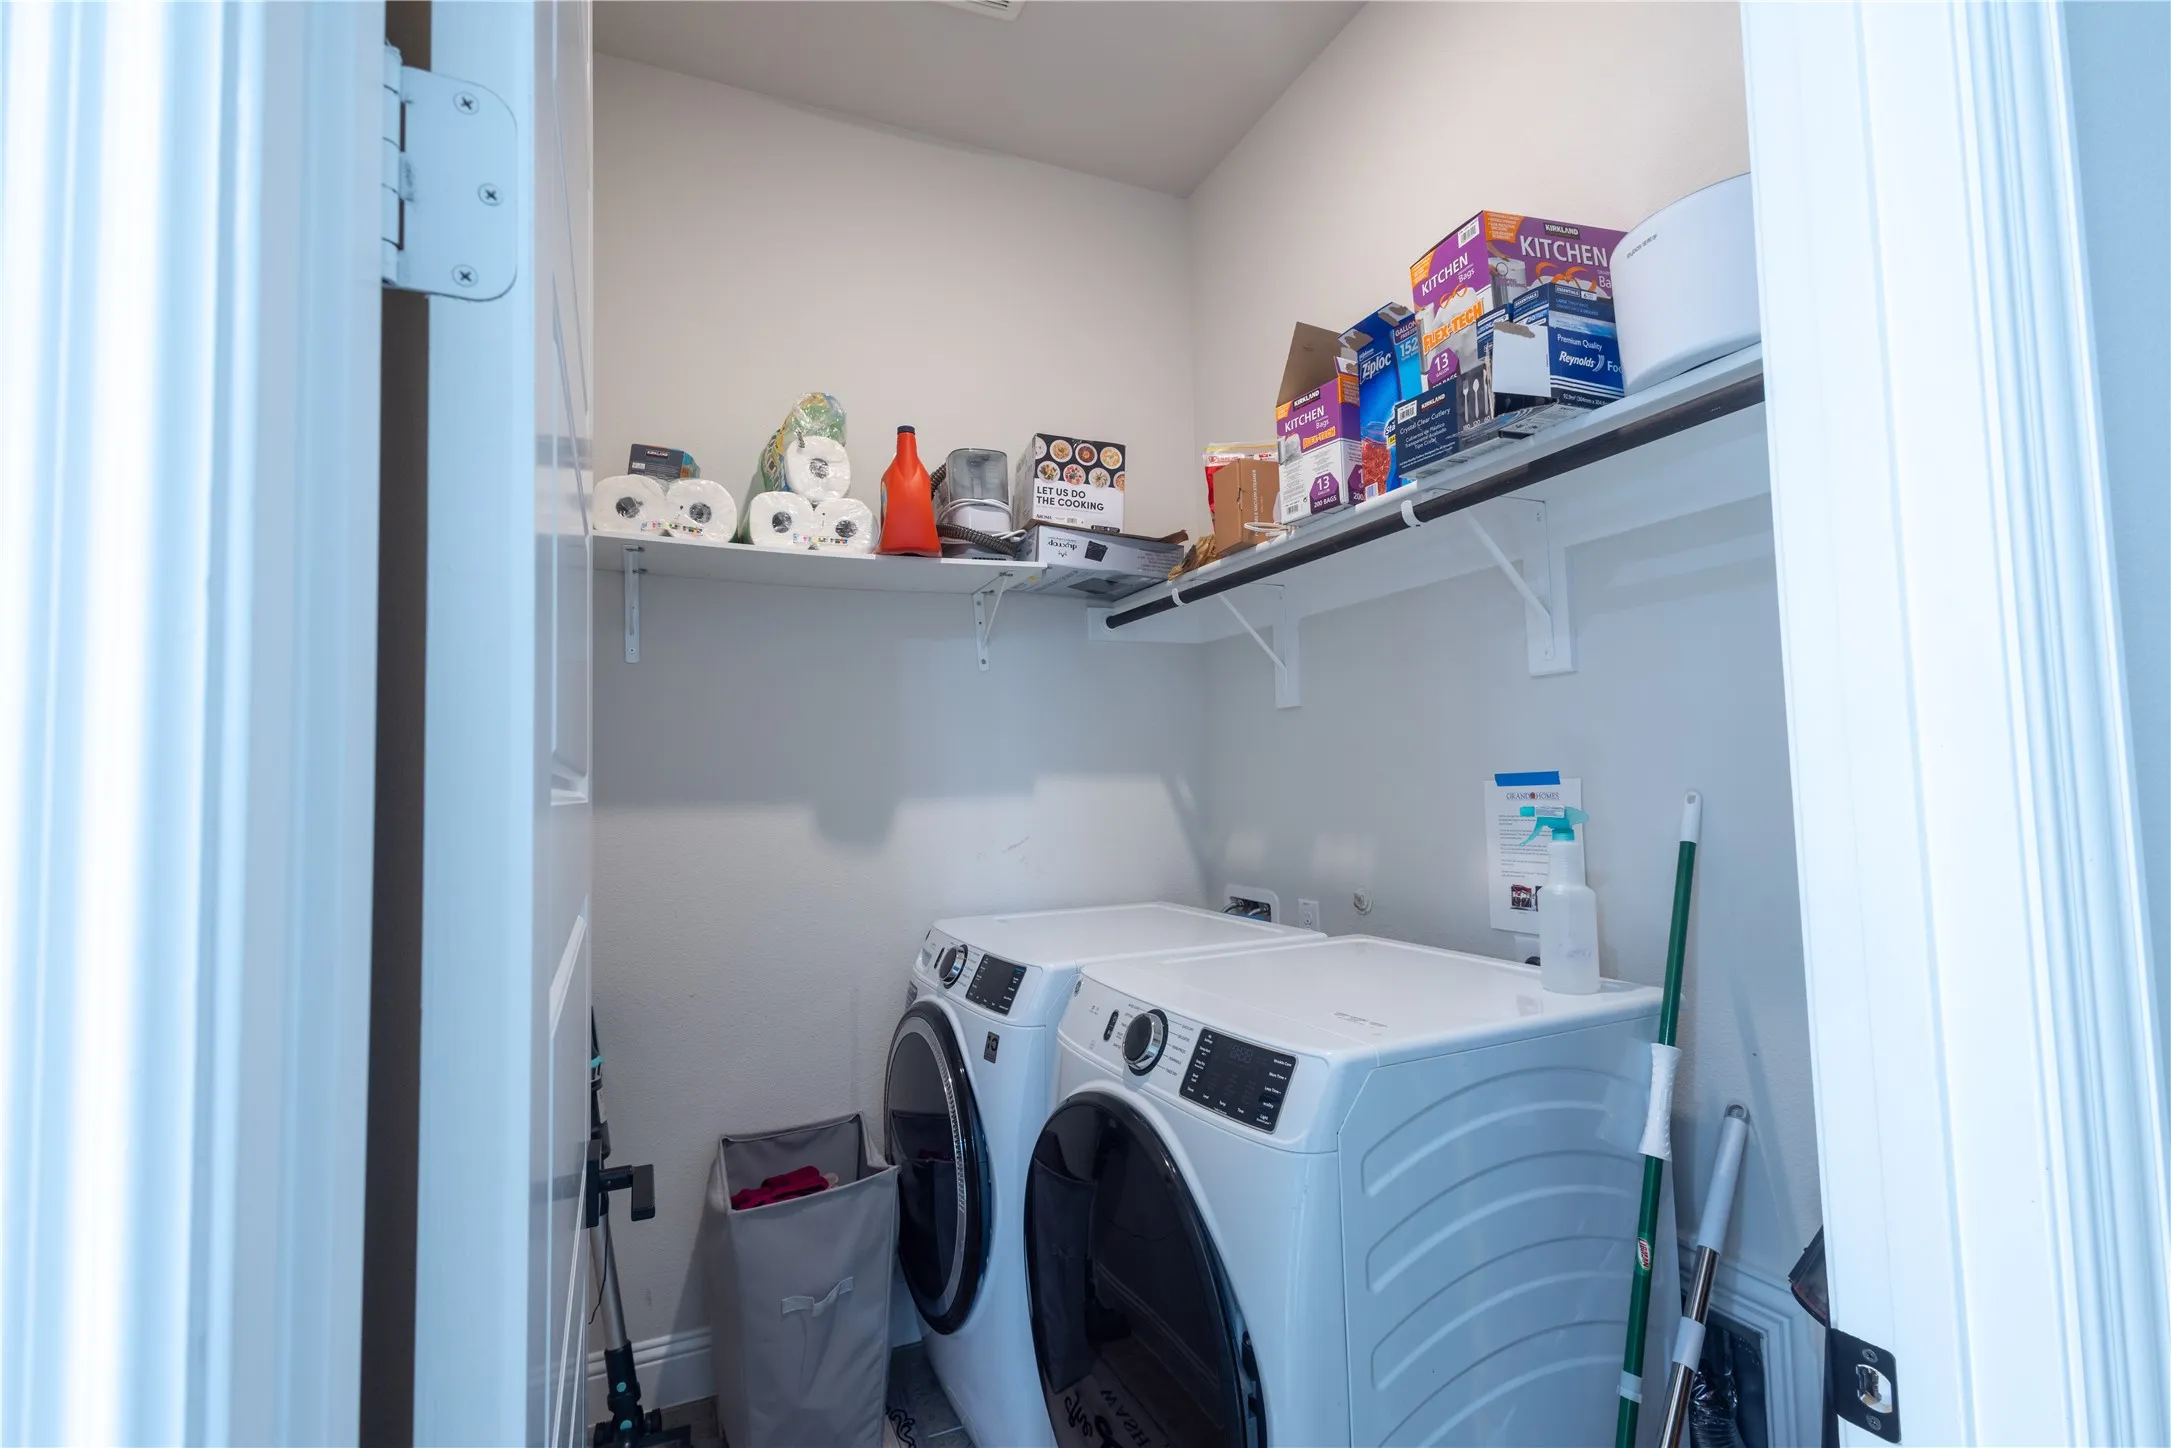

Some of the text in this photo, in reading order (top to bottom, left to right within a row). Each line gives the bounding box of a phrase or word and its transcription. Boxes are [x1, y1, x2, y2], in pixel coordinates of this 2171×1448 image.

[1544, 223, 1579, 236] KIRKLAND
[1520, 235, 1609, 268] KITCHEN
[1421, 252, 1469, 296] KITCHEN
[1458, 267, 1475, 284] Bags
[1598, 275, 1612, 289] Ba
[1422, 300, 1485, 354] FLEX-TECH
[1400, 336, 1418, 357] 152
[1557, 333, 1603, 352] Premium Quality
[1362, 353, 1392, 379] Ziploc
[1434, 353, 1450, 373] 13
[1559, 351, 1596, 369] Reynolds
[1293, 389, 1320, 407] KIRKLAND
[1421, 394, 1446, 409] KIRKLAND
[1284, 405, 1325, 432] KITCHEN
[1316, 419, 1329, 430] Bags
[1400, 408, 1451, 435] Crystal Clear Cutlery
[1302, 426, 1335, 449] FLEX-TECH
[1036, 486, 1086, 499] LET US DO
[1317, 475, 1330, 492] 13
[1036, 496, 1055, 506] THE
[1057, 498, 1105, 512] COOKING
[1313, 495, 1337, 508] 200 BAGS
[1506, 792, 1560, 800] GRAND HOMES
